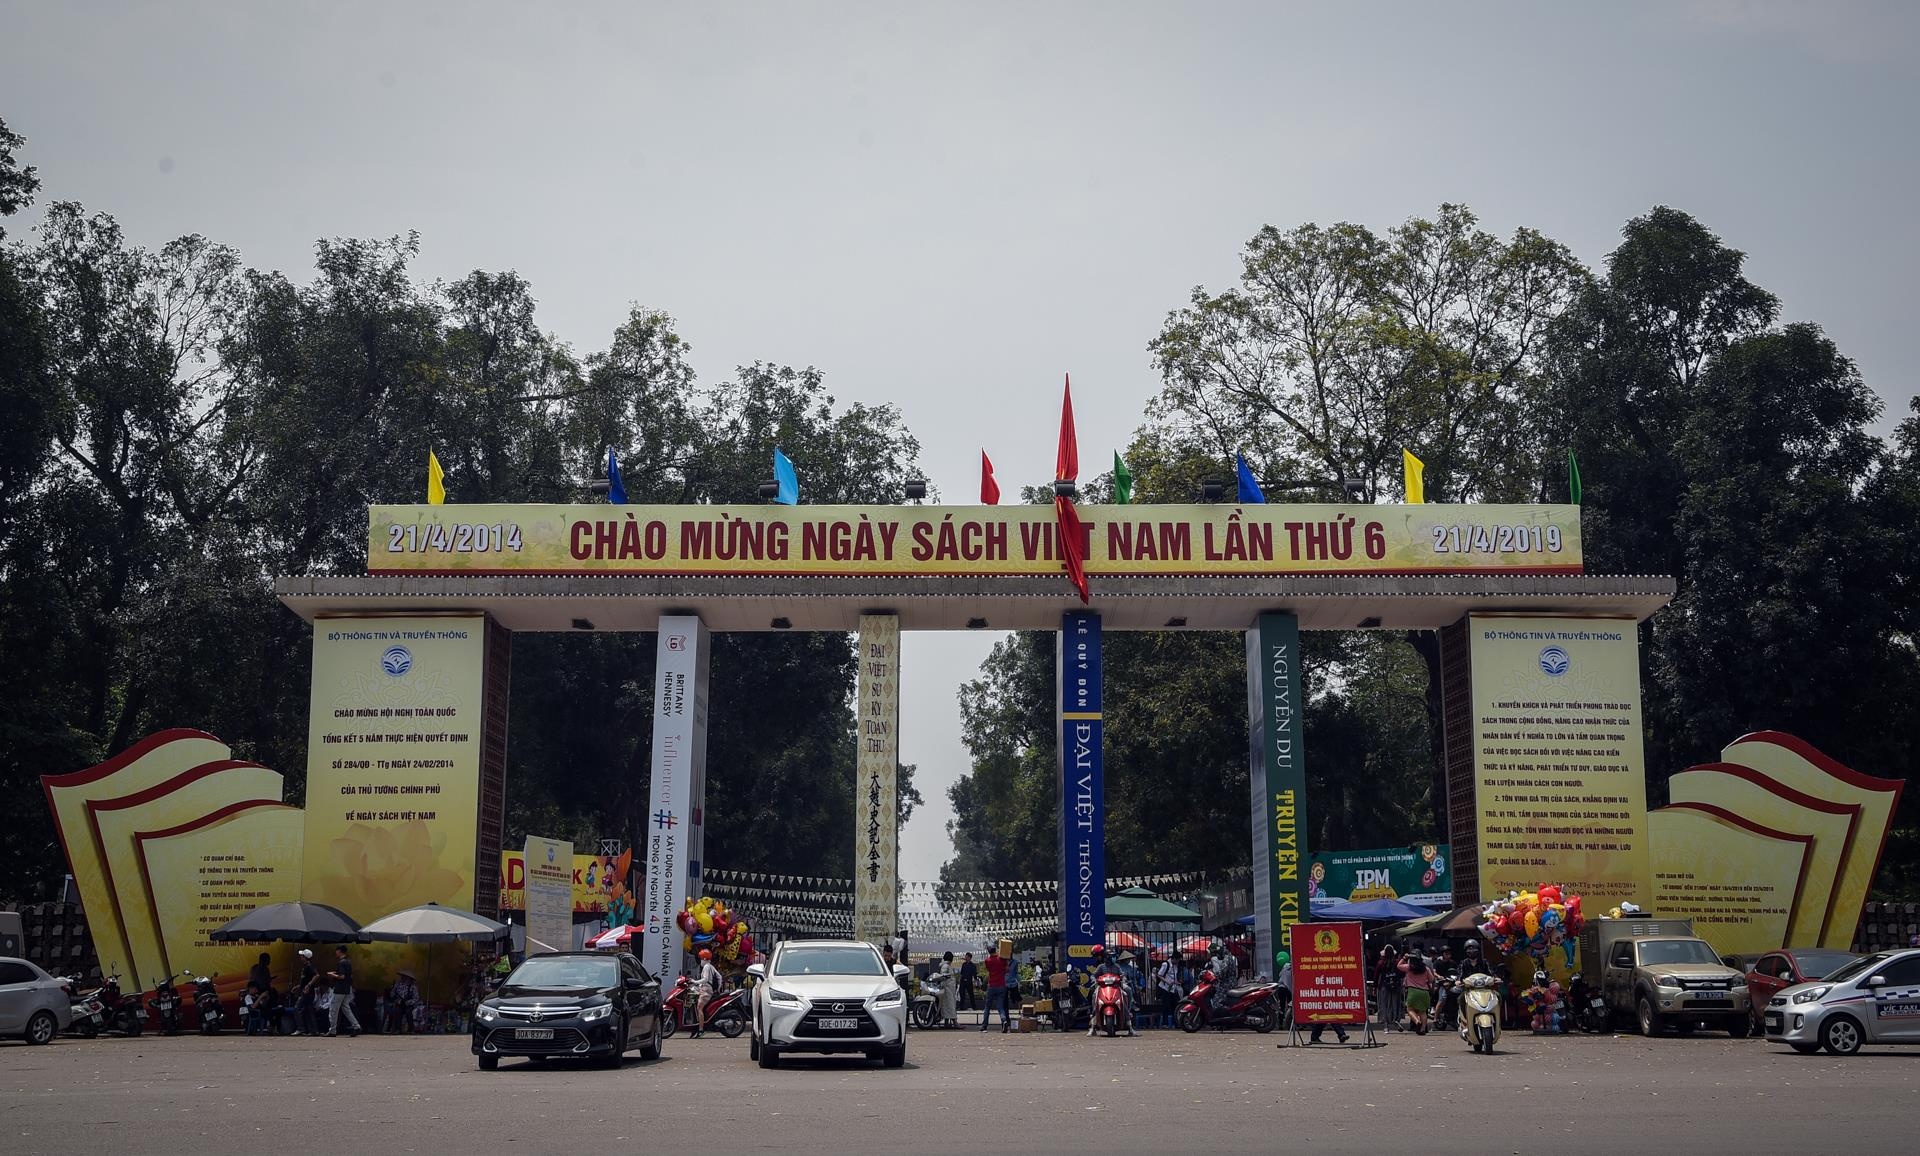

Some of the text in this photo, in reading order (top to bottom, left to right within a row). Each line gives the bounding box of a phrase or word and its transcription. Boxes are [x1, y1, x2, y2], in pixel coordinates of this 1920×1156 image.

[387, 523, 522, 552] 21/4/2014
[570, 513, 667, 561] CHÀO
[680, 512, 789, 561] MỪNG
[801, 513, 899, 561] NGÀY
[911, 514, 1008, 562] SÁCH
[1107, 522, 1192, 561] NAM
[1204, 508, 1273, 561] LẦN
[1284, 512, 1355, 561] THỨ
[1365, 521, 1386, 560] 6
[1432, 525, 1562, 553] 21/4/2019
[328, 630, 468, 643] BỘ THÔNG TIN VÀ TRUYỀN THÔNG
[670, 637, 679, 649] LD
[1484, 630, 1622, 642] BỘ THÔNG TIN VÀ TRUYỀN THÔNG
[871, 643, 885, 659] ĐẠI
[1077, 619, 1088, 707] LÊ QUÝ ĐÔN
[663, 672, 672, 717] HENNESSY
[675, 674, 684, 715] BRITTANY
[334, 705, 456, 718] CHÀO MỪNG HỘI NGHỊ TOÀN QUỐC
[1272, 644, 1294, 768] NGUYỄN DU
[323, 733, 342, 744] TỔNG
[343, 732, 357, 743] KẾT
[365, 733, 383, 743] NĂM
[385, 734, 404, 744] THỰC
[406, 733, 424, 744] HIỆN
[425, 731, 448, 742] QUYẾT
[450, 734, 468, 744] ĐỊNH
[332, 758, 454, 769] SỐ 284/QĐ TTg NGÀY 24/02/2014
[661, 734, 681, 806] influencer
[341, 783, 441, 795] CỦA THỦ TƯỚNG CHÍNH PHỦ
[345, 810, 436, 822] VỀ NGÀY SÁCH VIỆT NAM
[1074, 723, 1095, 937] ĐẠI VIỆT THÔNG SỬ
[1275, 789, 1299, 881] TRUYỆN
[649, 835, 661, 934] TRONG KỶ NGUYÊN 4.0
[1355, 868, 1390, 890] IPM
[661, 835, 675, 977] XÂY DỰNG THƯƠNG HIỆU CÁ NHÂN
[1315, 974, 1343, 986] ĐỀ NGHỊ
[1299, 986, 1359, 997] NHÂN DÂN GỬI XE
[1299, 1000, 1360, 1010] TRONG CÔNG VIÊN
